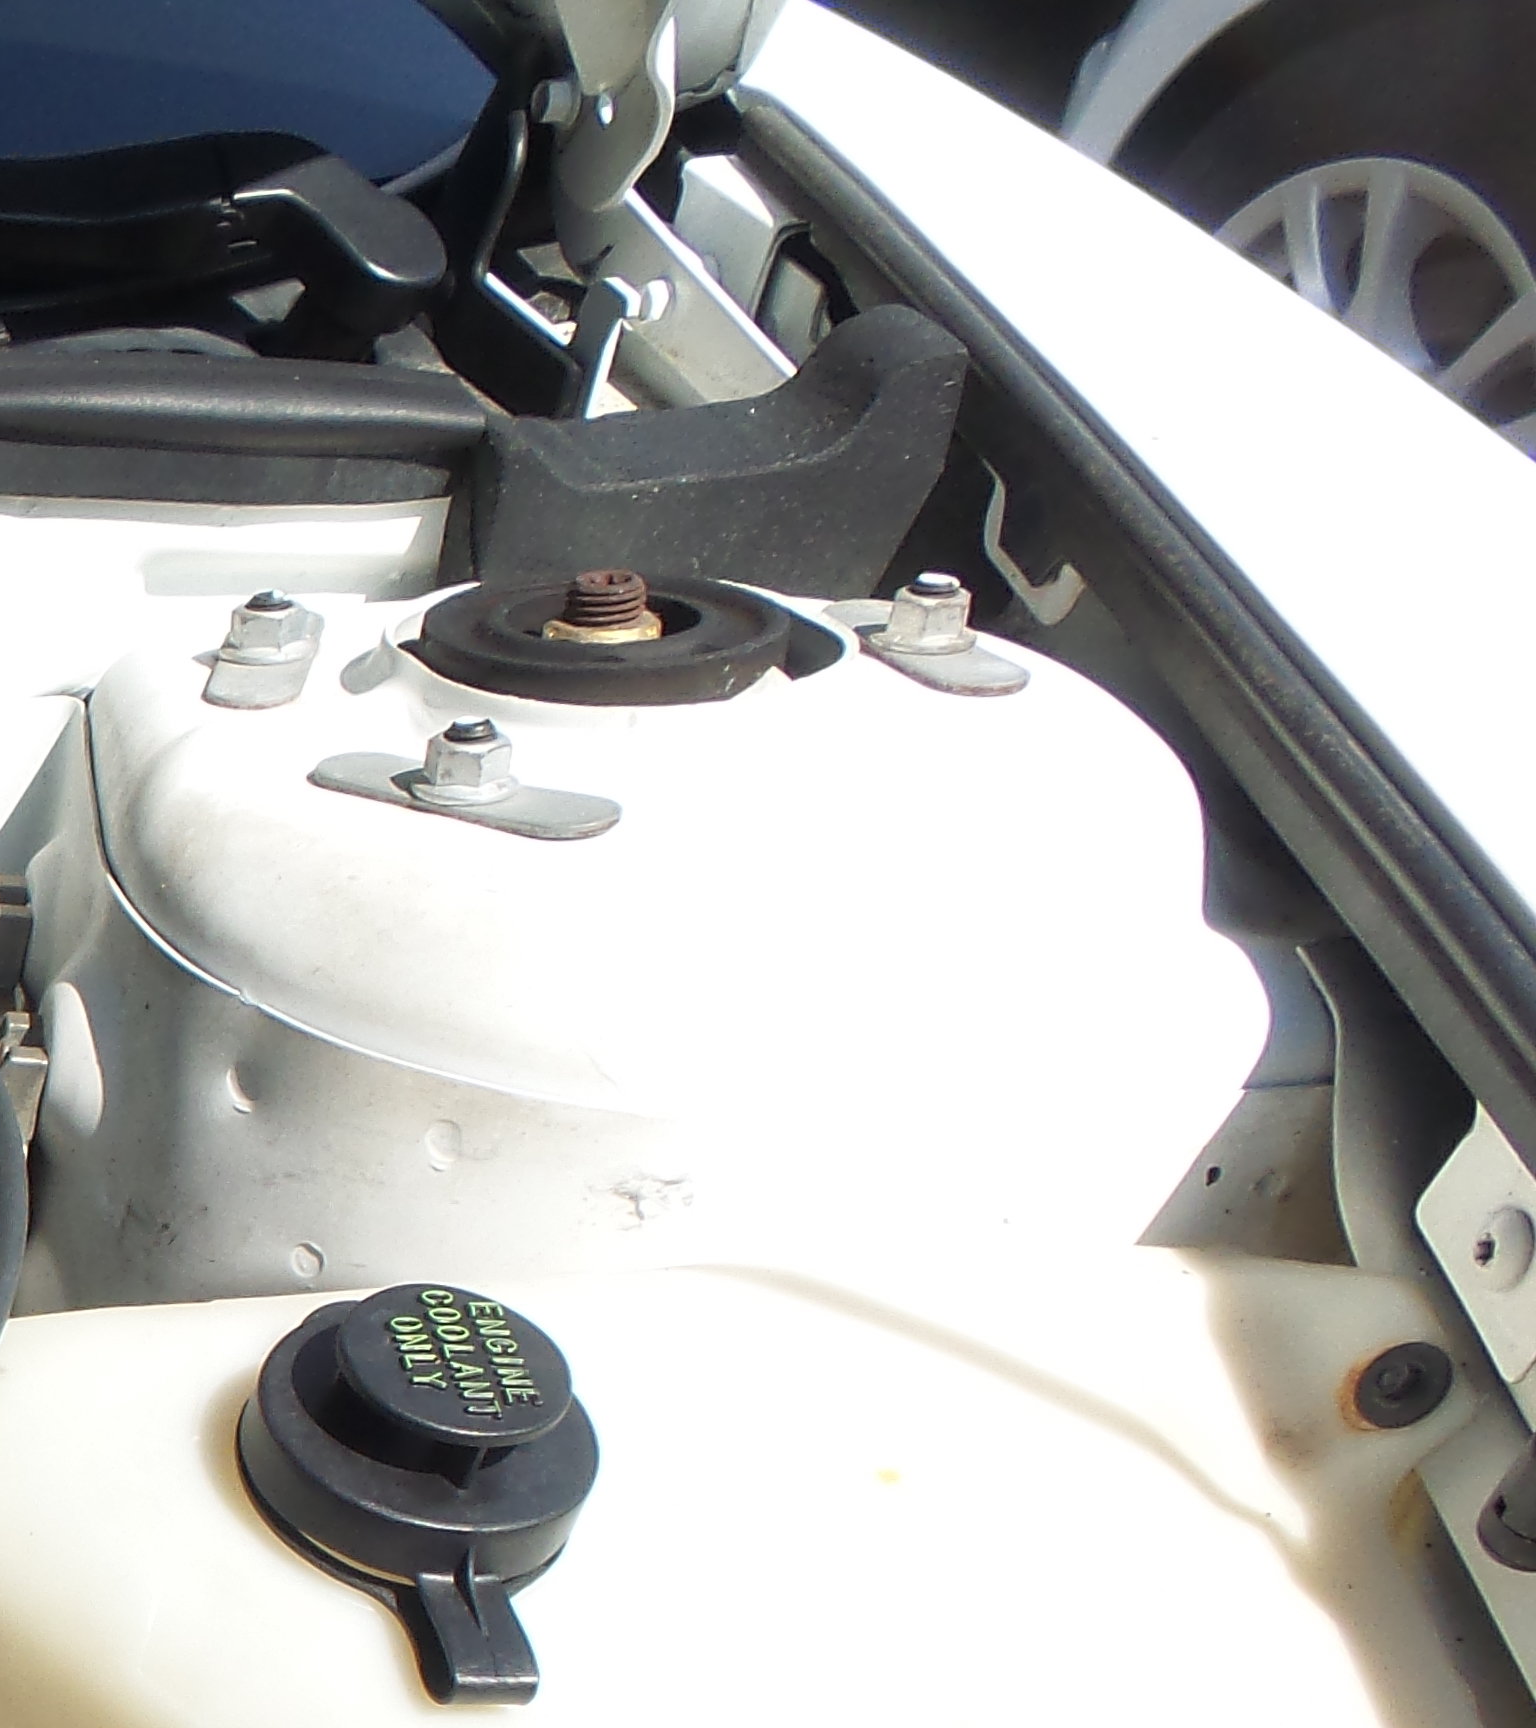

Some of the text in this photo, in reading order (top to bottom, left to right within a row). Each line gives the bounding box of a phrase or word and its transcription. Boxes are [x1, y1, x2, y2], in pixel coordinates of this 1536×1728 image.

[389, 1316, 449, 1389] ONLY
[420, 1289, 504, 1420] COOLANT
[467, 1301, 545, 1406] ENGINE
